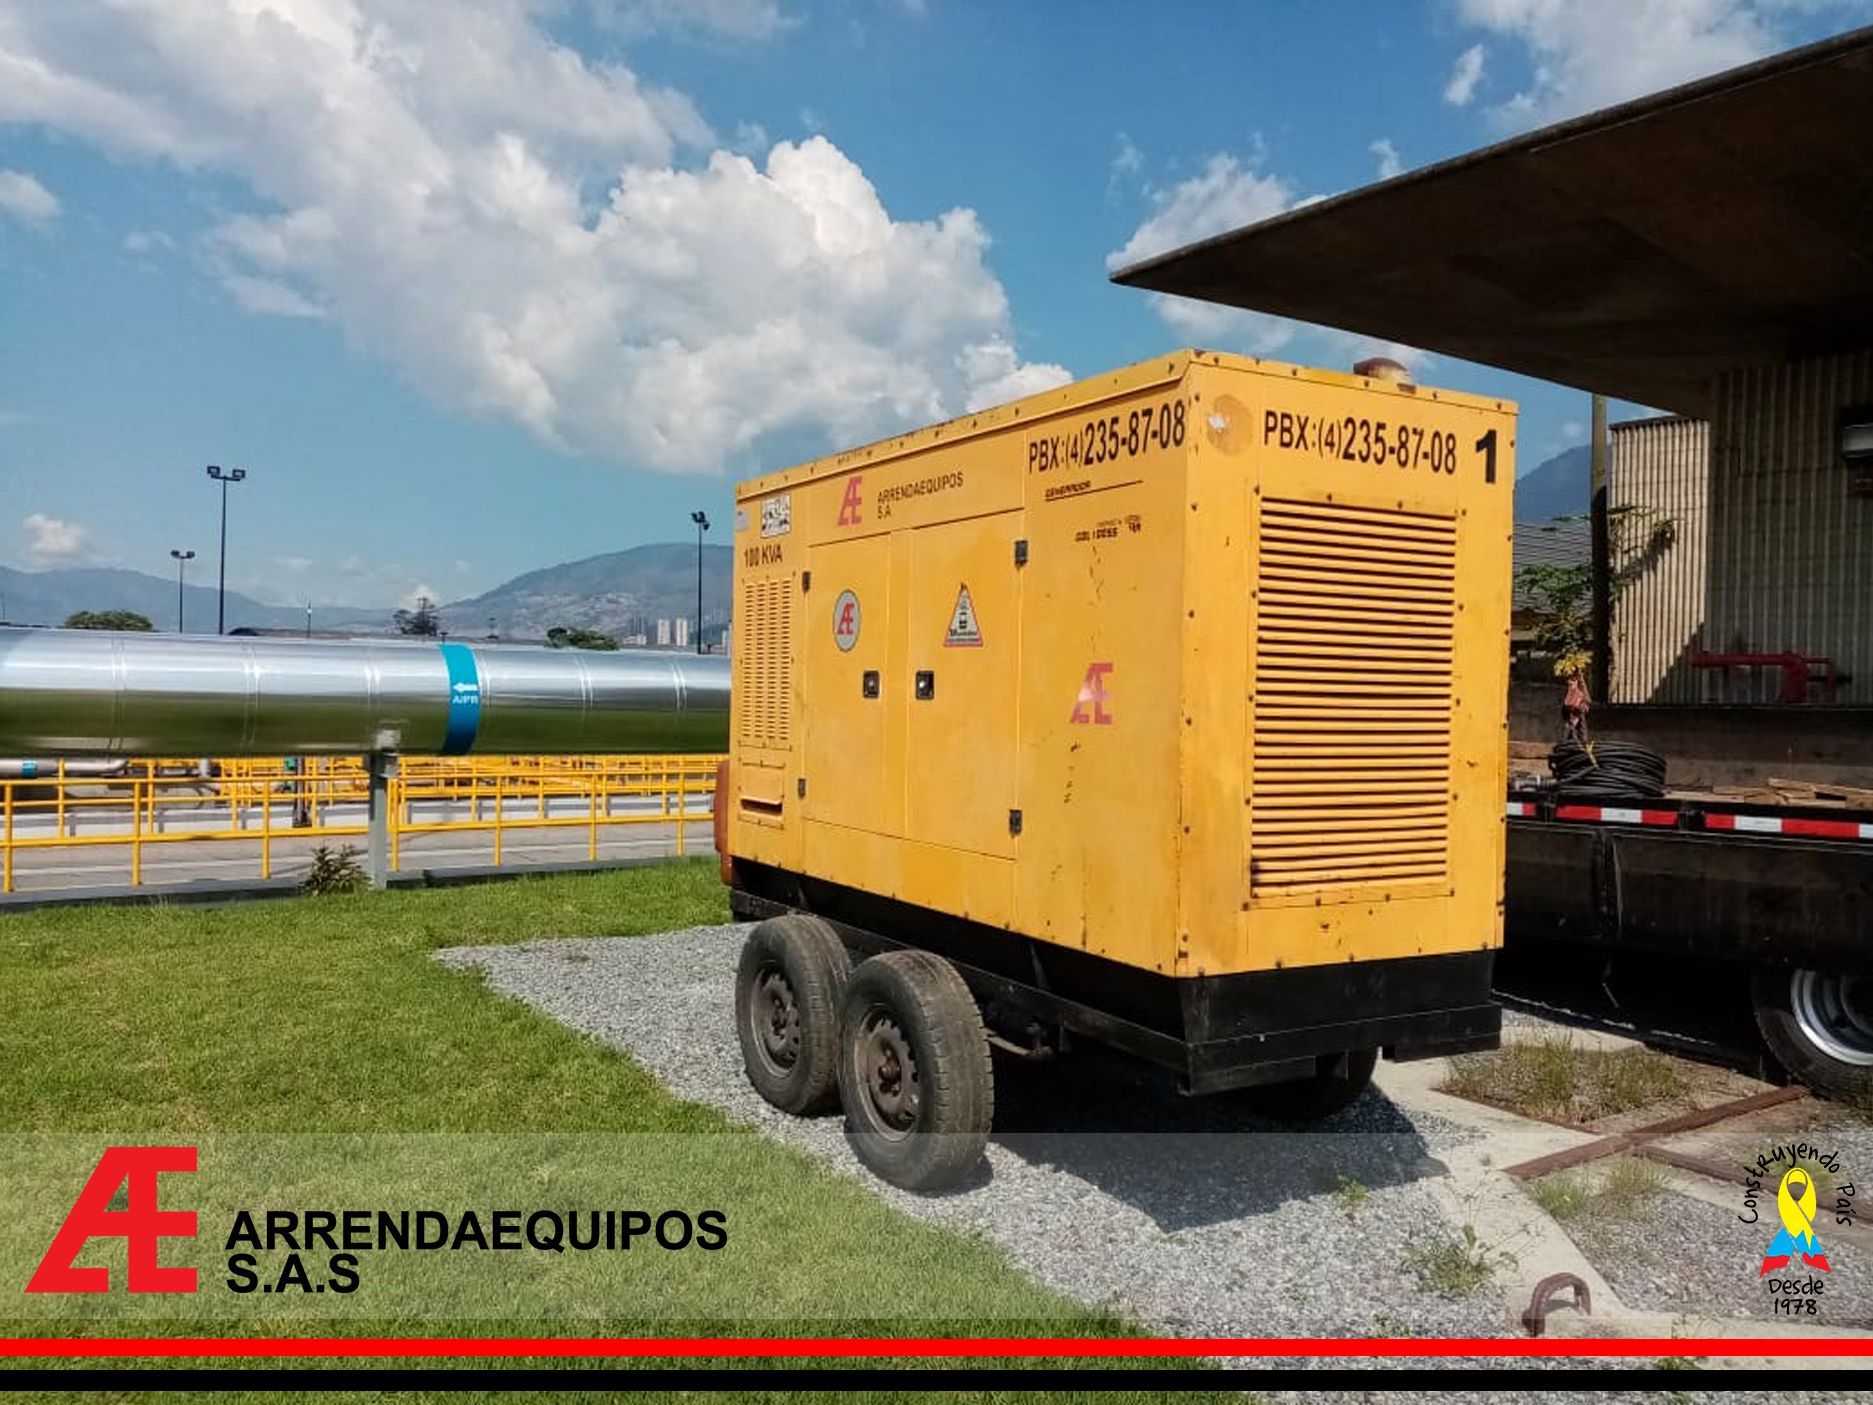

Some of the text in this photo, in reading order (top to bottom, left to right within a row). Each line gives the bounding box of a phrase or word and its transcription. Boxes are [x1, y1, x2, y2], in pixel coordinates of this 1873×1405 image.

[1475, 428, 1498, 485] 1
[877, 471, 964, 505] ARRENDAEQUIPOS
[744, 543, 783, 568] 100 KVA
